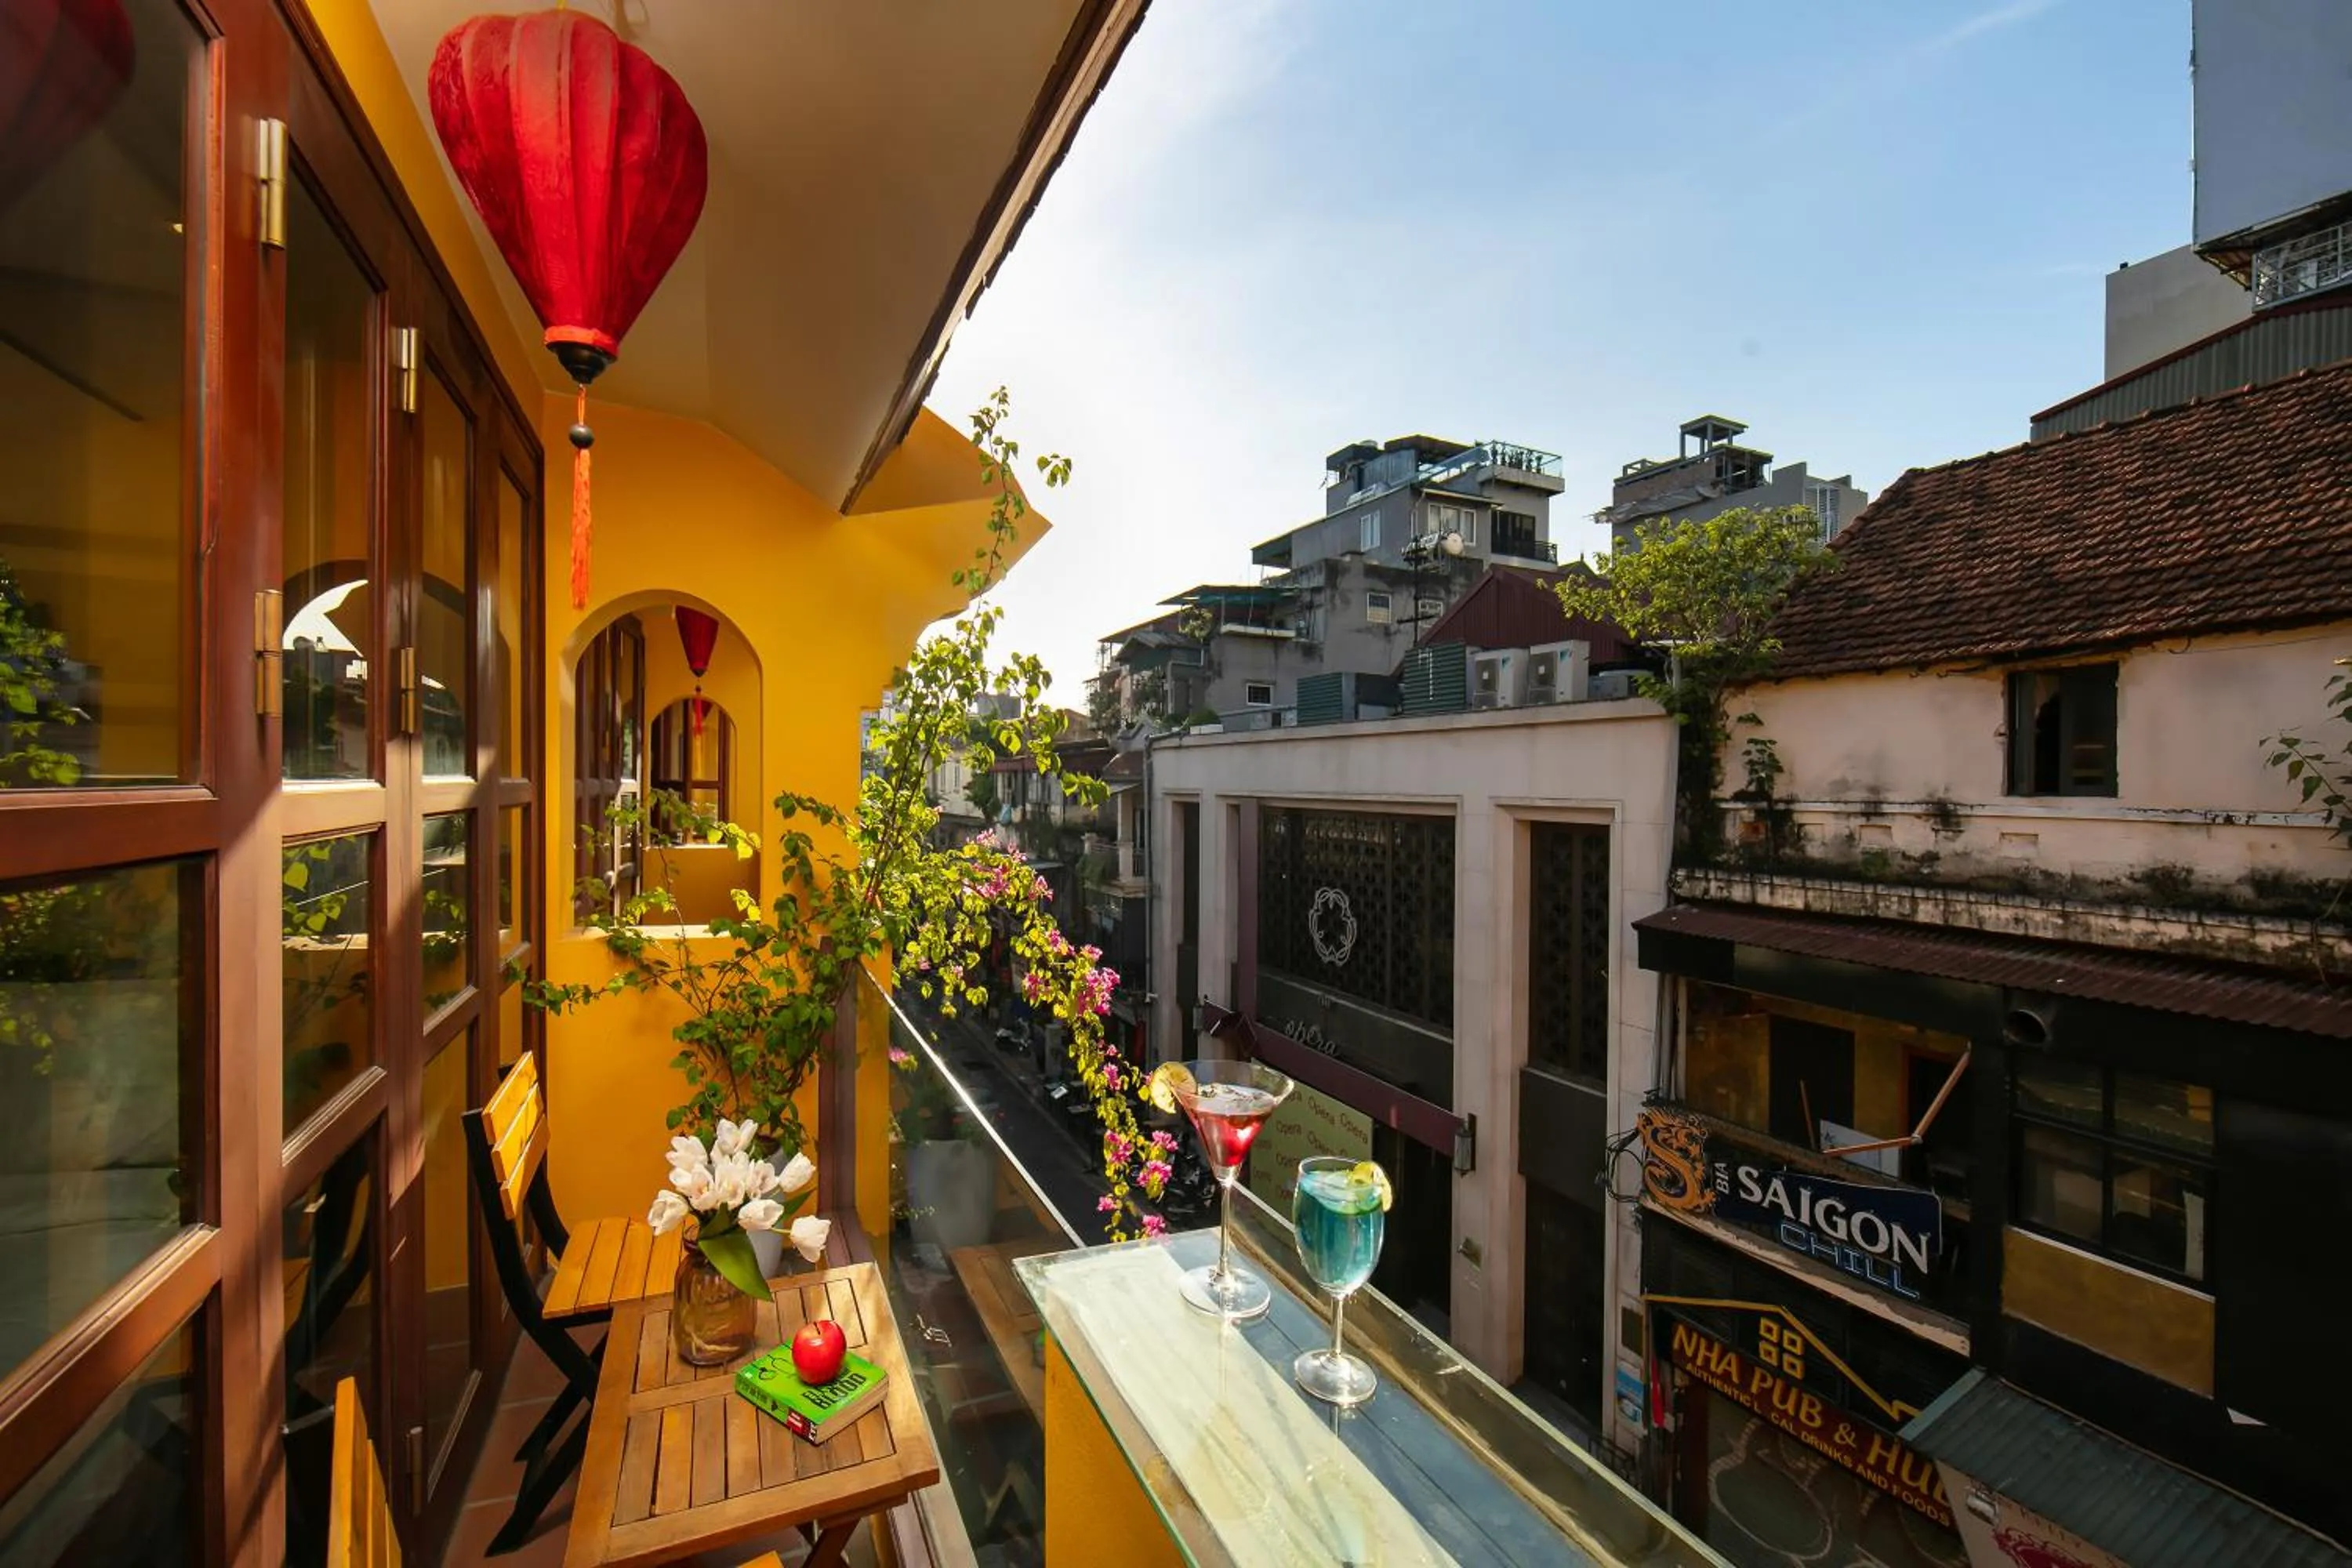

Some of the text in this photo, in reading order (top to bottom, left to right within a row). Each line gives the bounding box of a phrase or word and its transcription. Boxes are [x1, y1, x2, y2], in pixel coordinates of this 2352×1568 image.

[1715, 1162, 1730, 1196] BIA
[1737, 1165, 1931, 1274] SAIGON
[1780, 1221, 1920, 1300] CHILL
[1672, 1323, 1741, 1385] NHA
[1750, 1365, 1824, 1429] PUB
[1833, 1421, 1857, 1449] &
[1685, 1362, 1751, 1409] AUTHENTIC
[1752, 1399, 1798, 1437] LCAL
[1801, 1429, 1854, 1468] DRINKS
[1856, 1463, 1890, 1491] AND
